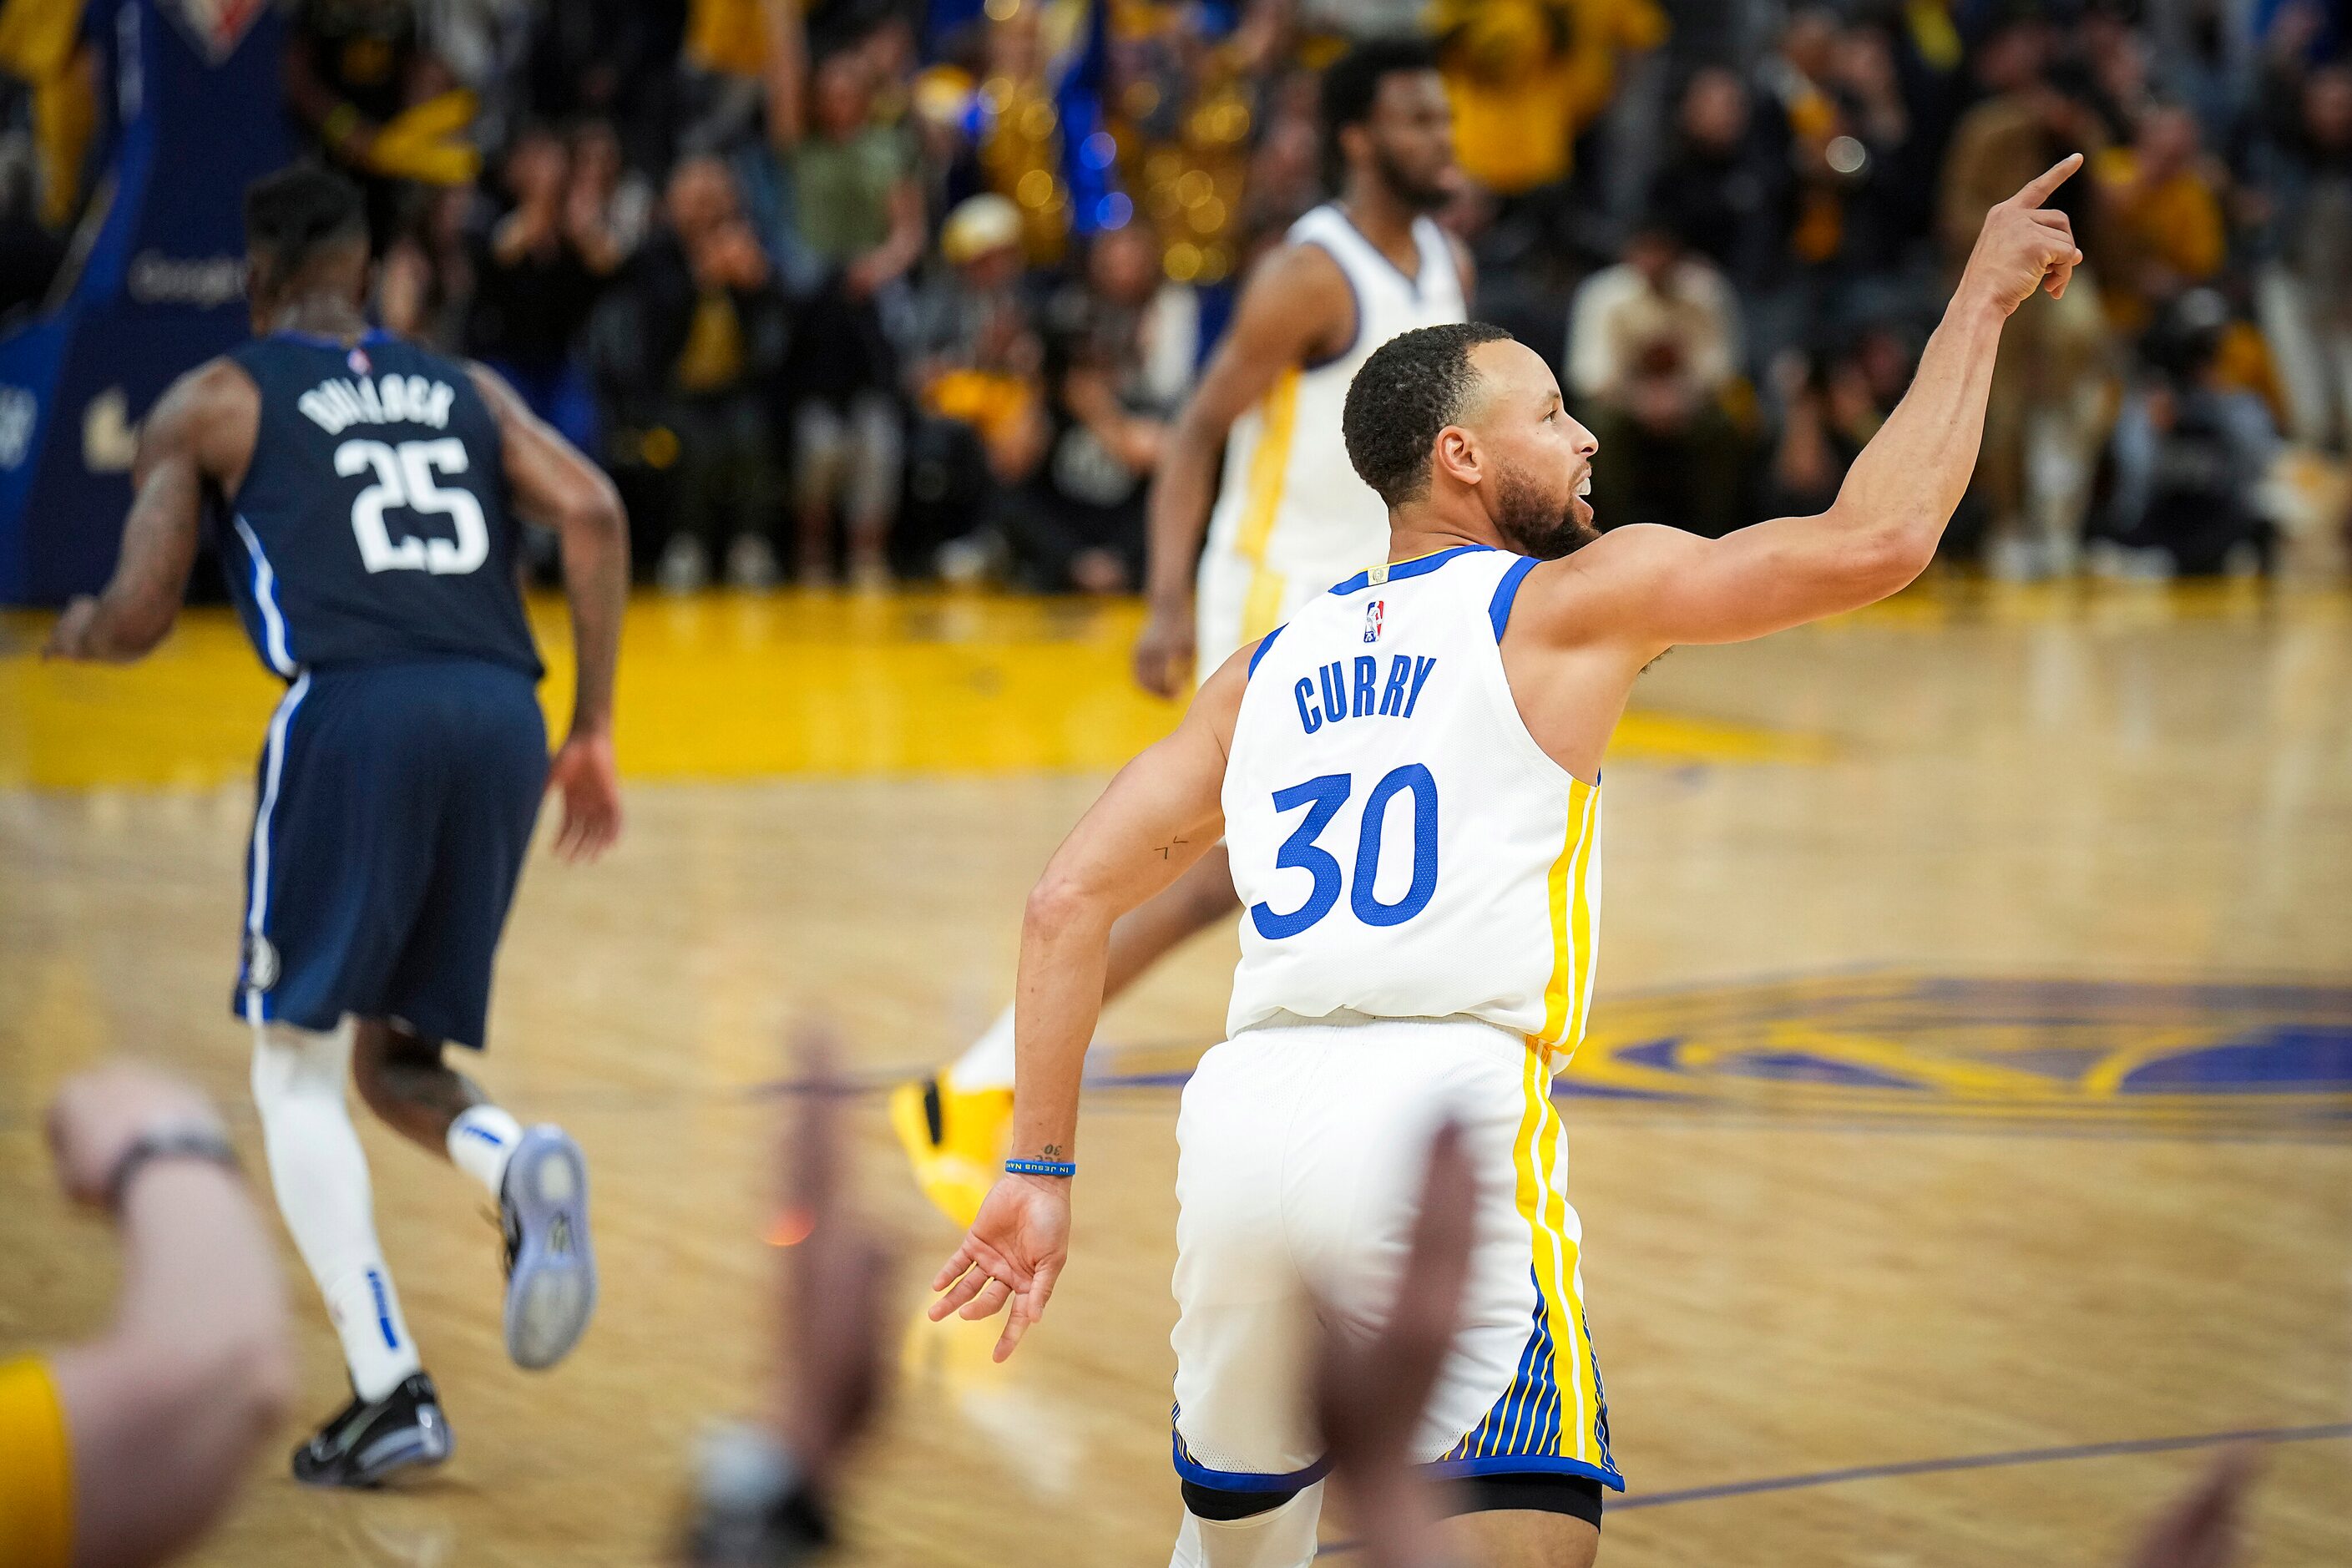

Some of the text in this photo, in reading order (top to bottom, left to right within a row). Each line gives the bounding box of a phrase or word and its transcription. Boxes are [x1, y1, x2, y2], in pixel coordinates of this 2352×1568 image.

[298, 373, 455, 435] BULLOCK
[334, 438, 489, 574] 25
[1294, 655, 1437, 734] CURRY
[1251, 763, 1438, 939] 30
